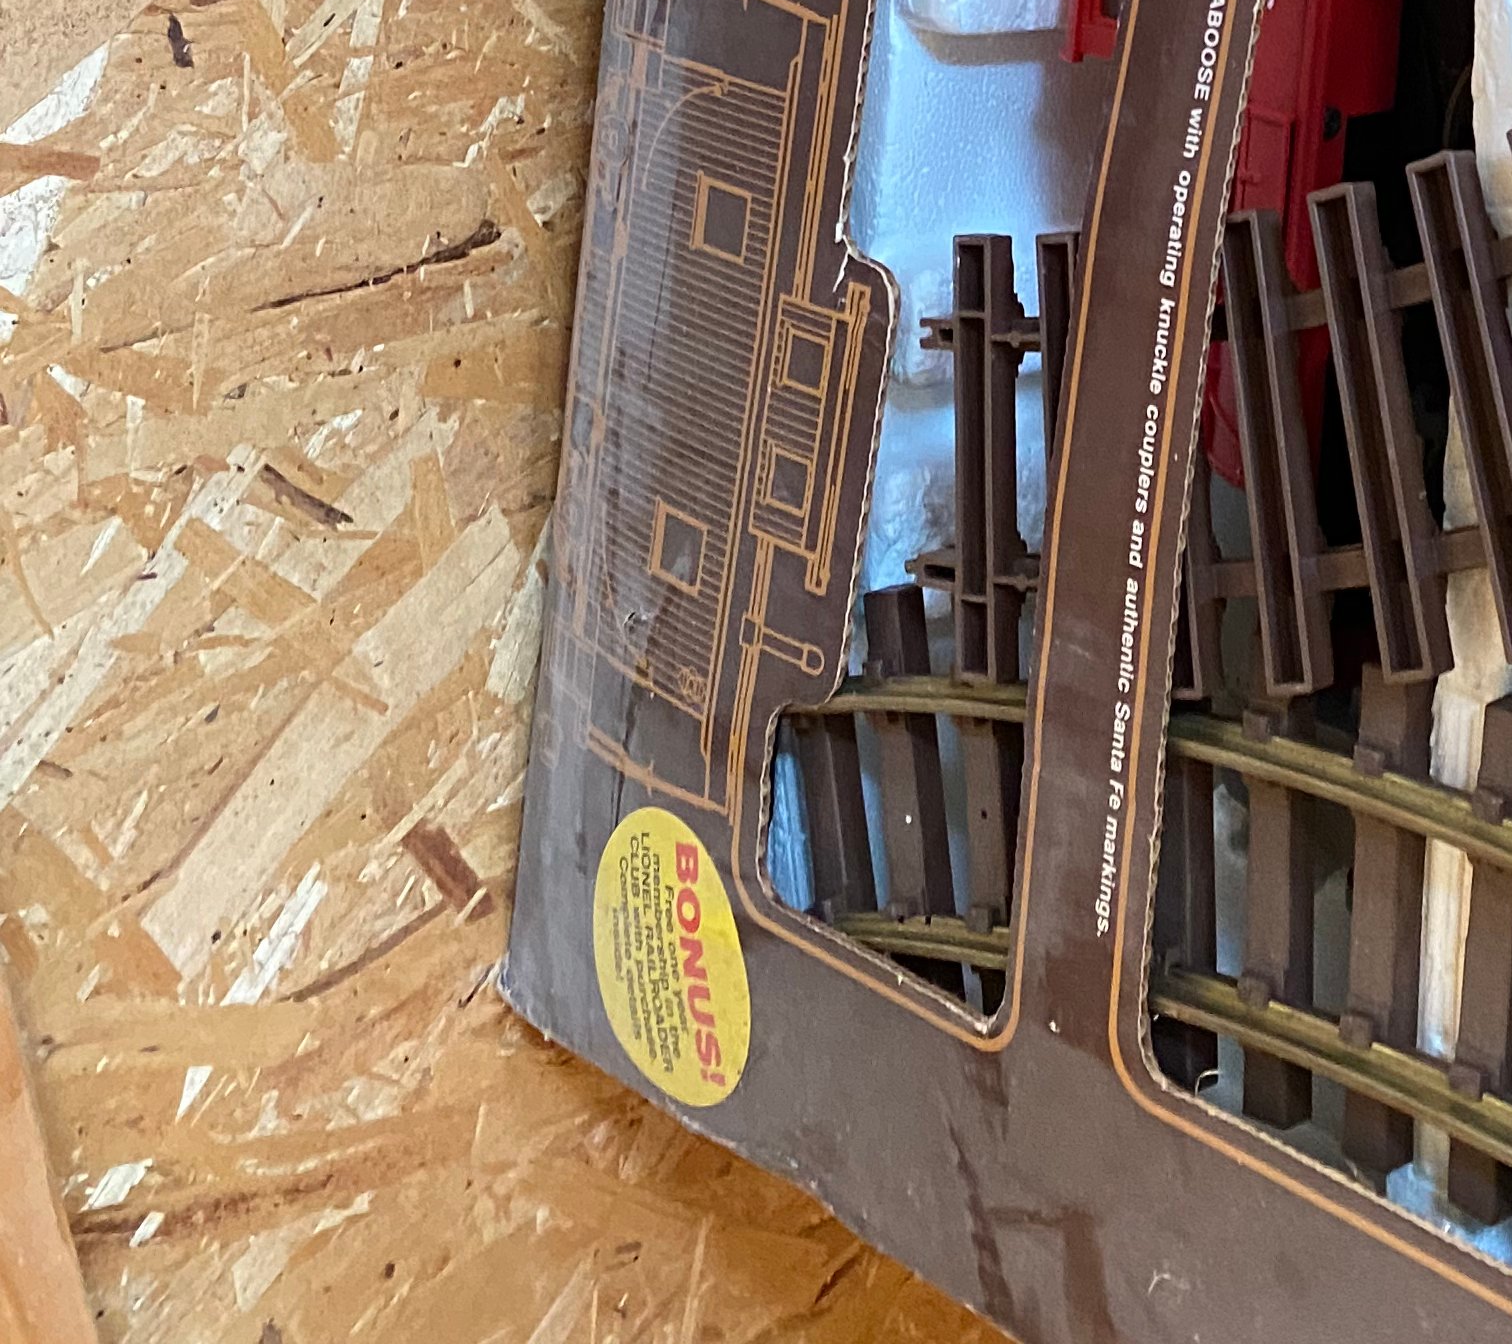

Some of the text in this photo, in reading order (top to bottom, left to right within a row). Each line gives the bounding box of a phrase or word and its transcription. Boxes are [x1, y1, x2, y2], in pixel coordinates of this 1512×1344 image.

[1183, 109, 1202, 158] with
[1160, 171, 1190, 286] operating
[1150, 299, 1175, 394] knuckle
[1135, 405, 1158, 513] couplers
[1129, 520, 1144, 568] and
[1118, 579, 1138, 692] authentic
[1110, 702, 1130, 772] Santa
[1109, 779, 1124, 810] Fe
[630, 835, 640, 897] CLUB
[1095, 816, 1117, 936] markings.
[640, 832, 673, 1073] LIONEL RAILROADER
[675, 841, 725, 1086] BONUS!
